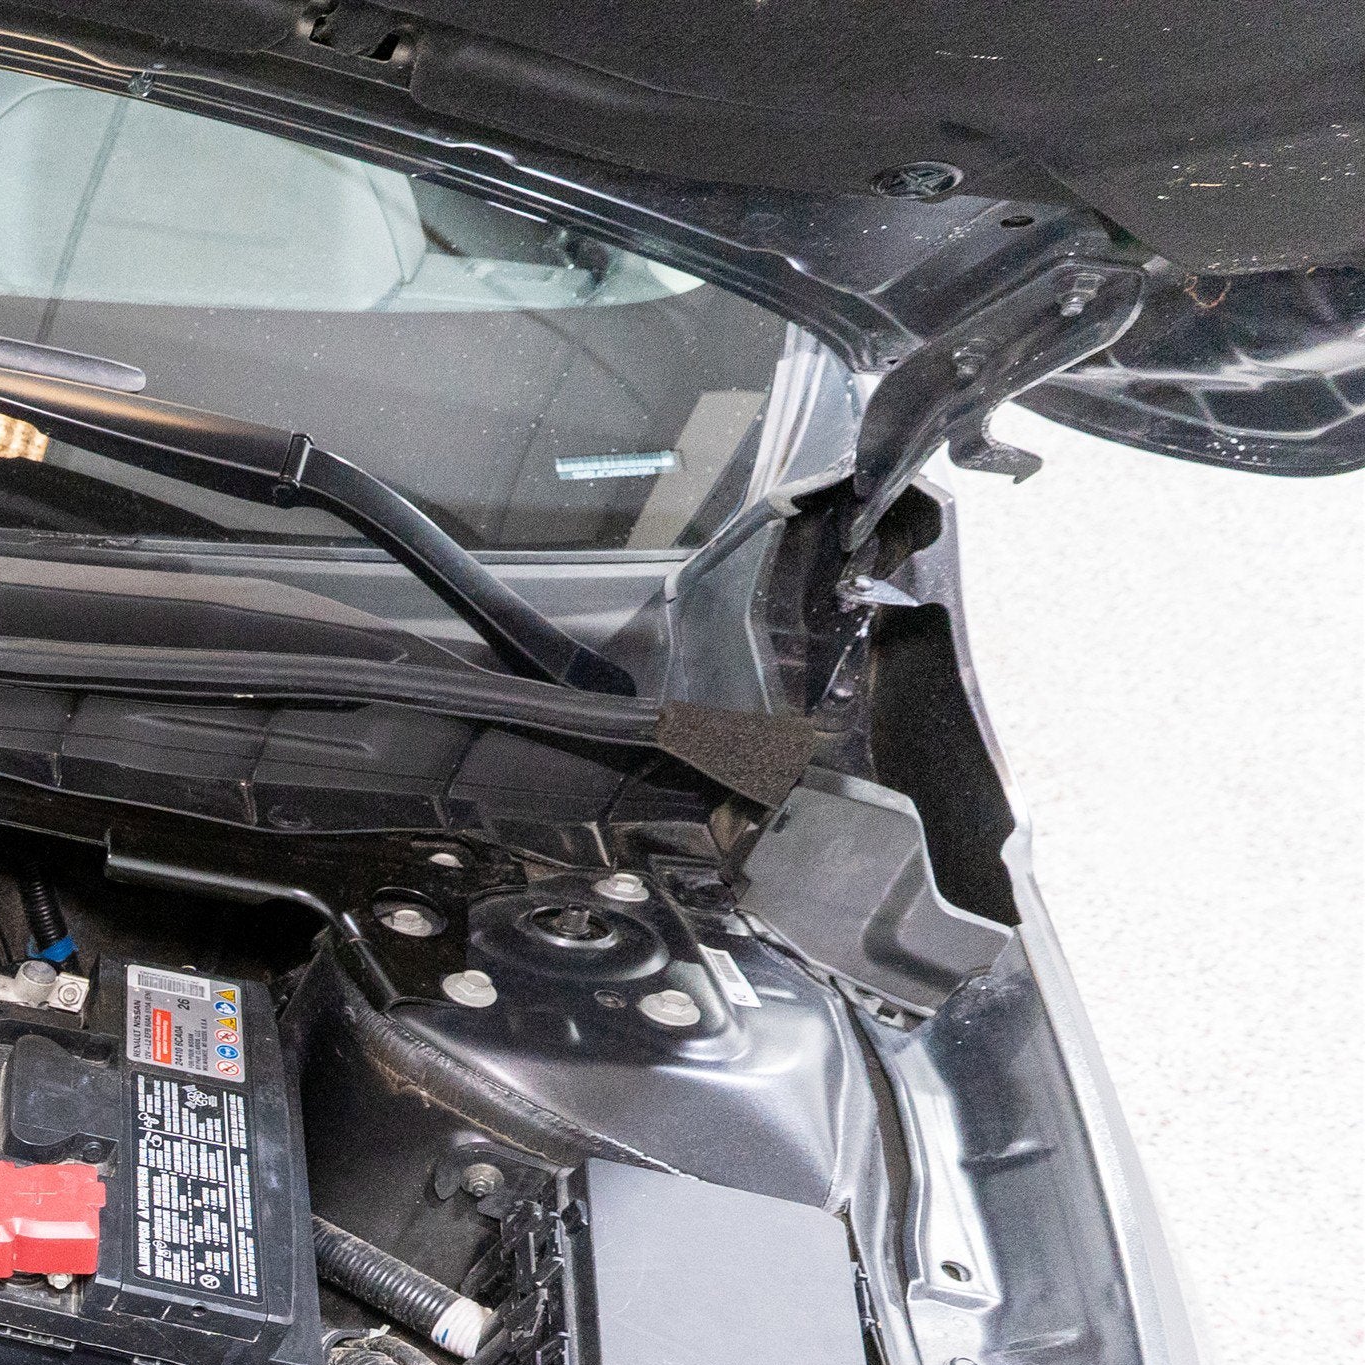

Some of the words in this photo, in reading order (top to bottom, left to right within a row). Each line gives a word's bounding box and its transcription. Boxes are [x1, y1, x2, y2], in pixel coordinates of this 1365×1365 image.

[133, 999, 141, 1028] NISSAN
[177, 997, 190, 1010] 26
[133, 1029, 141, 1058] RENAULT
